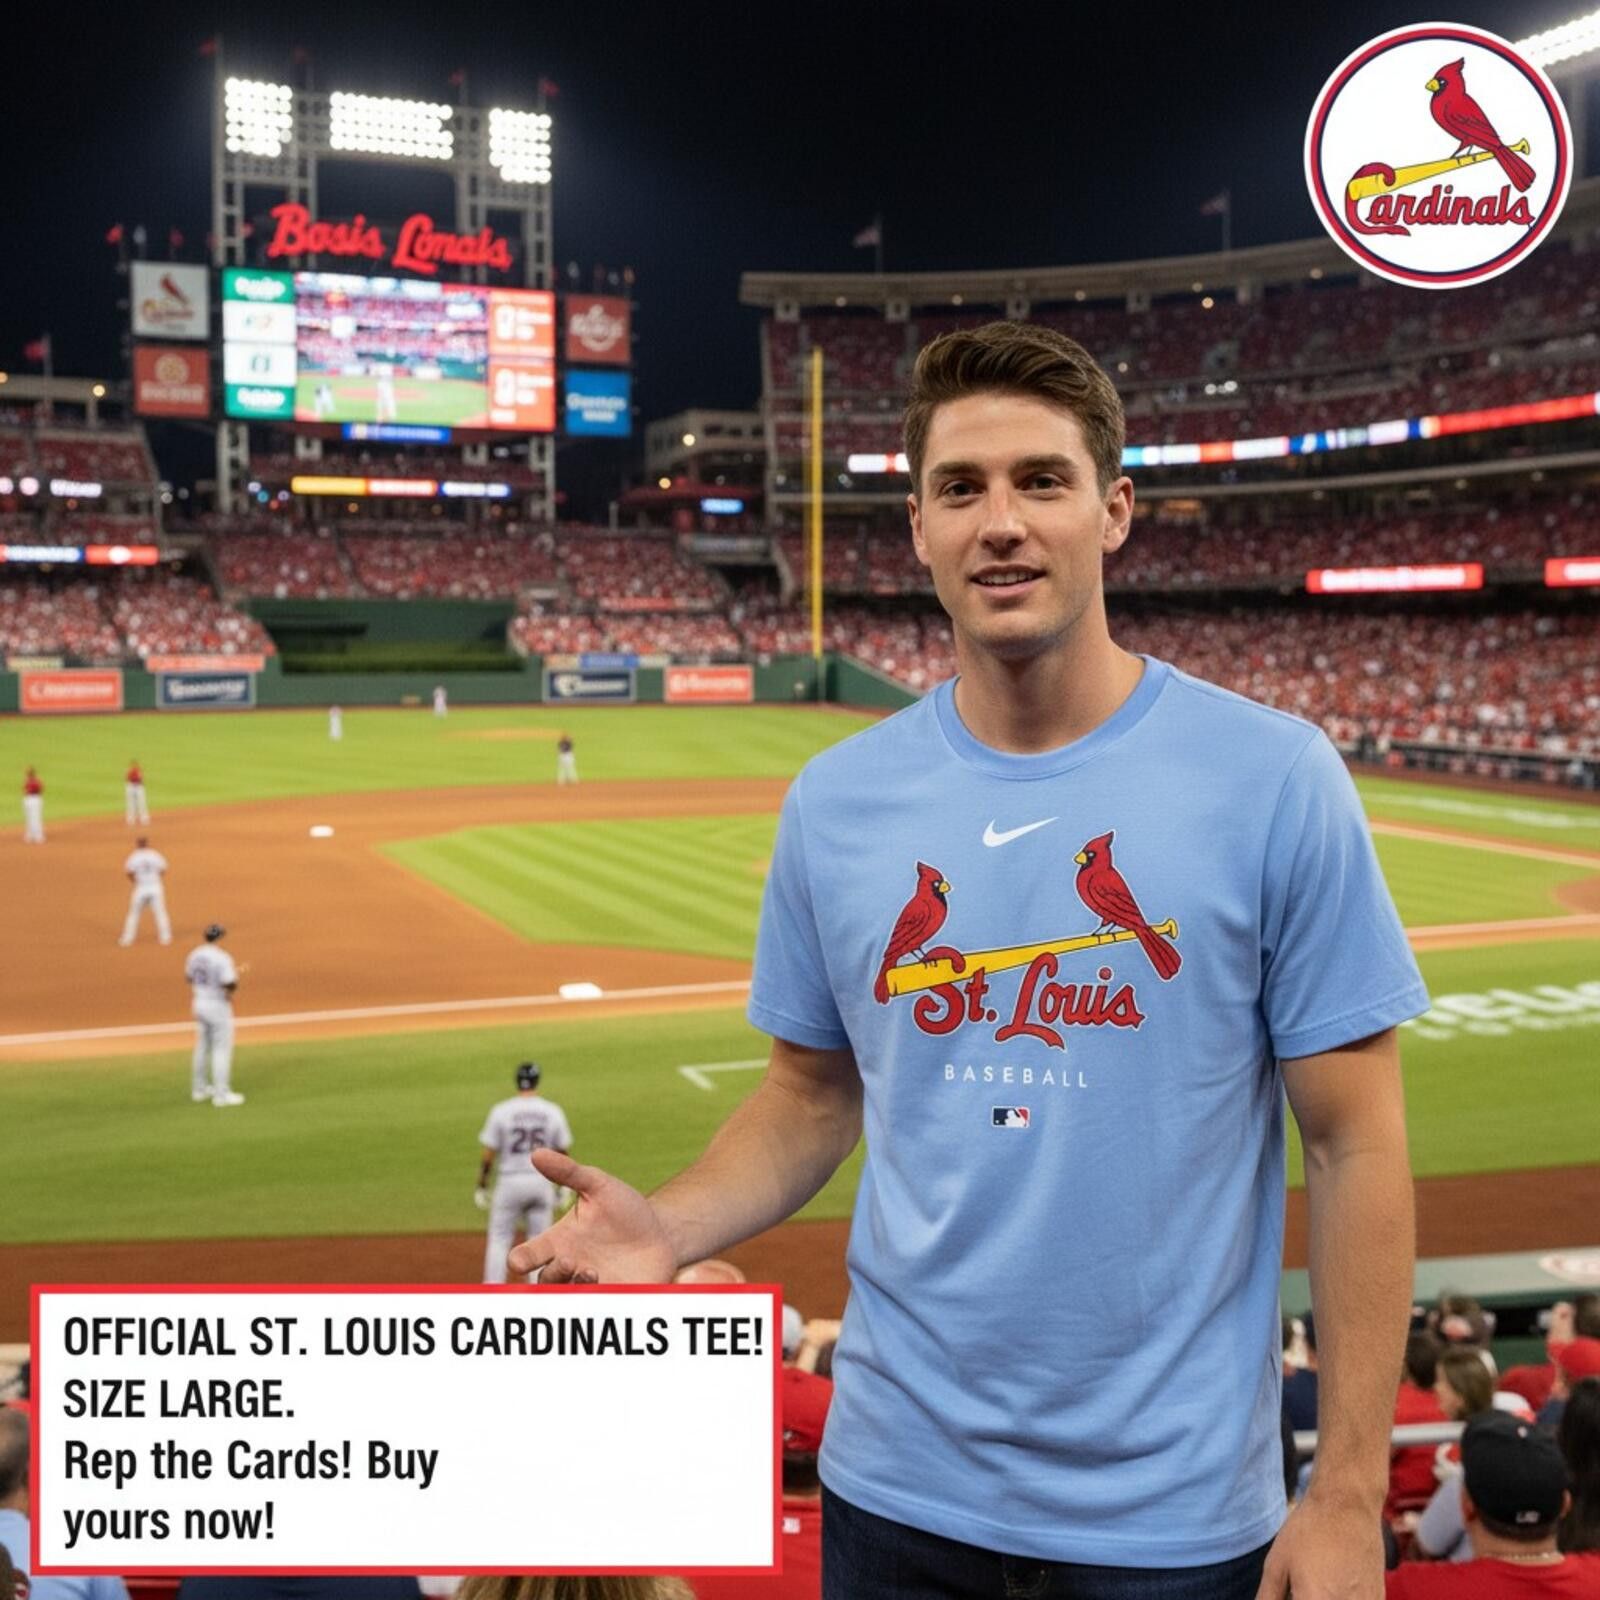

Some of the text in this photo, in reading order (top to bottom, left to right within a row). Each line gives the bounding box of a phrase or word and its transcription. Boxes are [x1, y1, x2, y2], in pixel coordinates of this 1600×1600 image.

[913, 946, 1147, 1051] St. Louis
[944, 1063, 1089, 1089] BASEBALL
